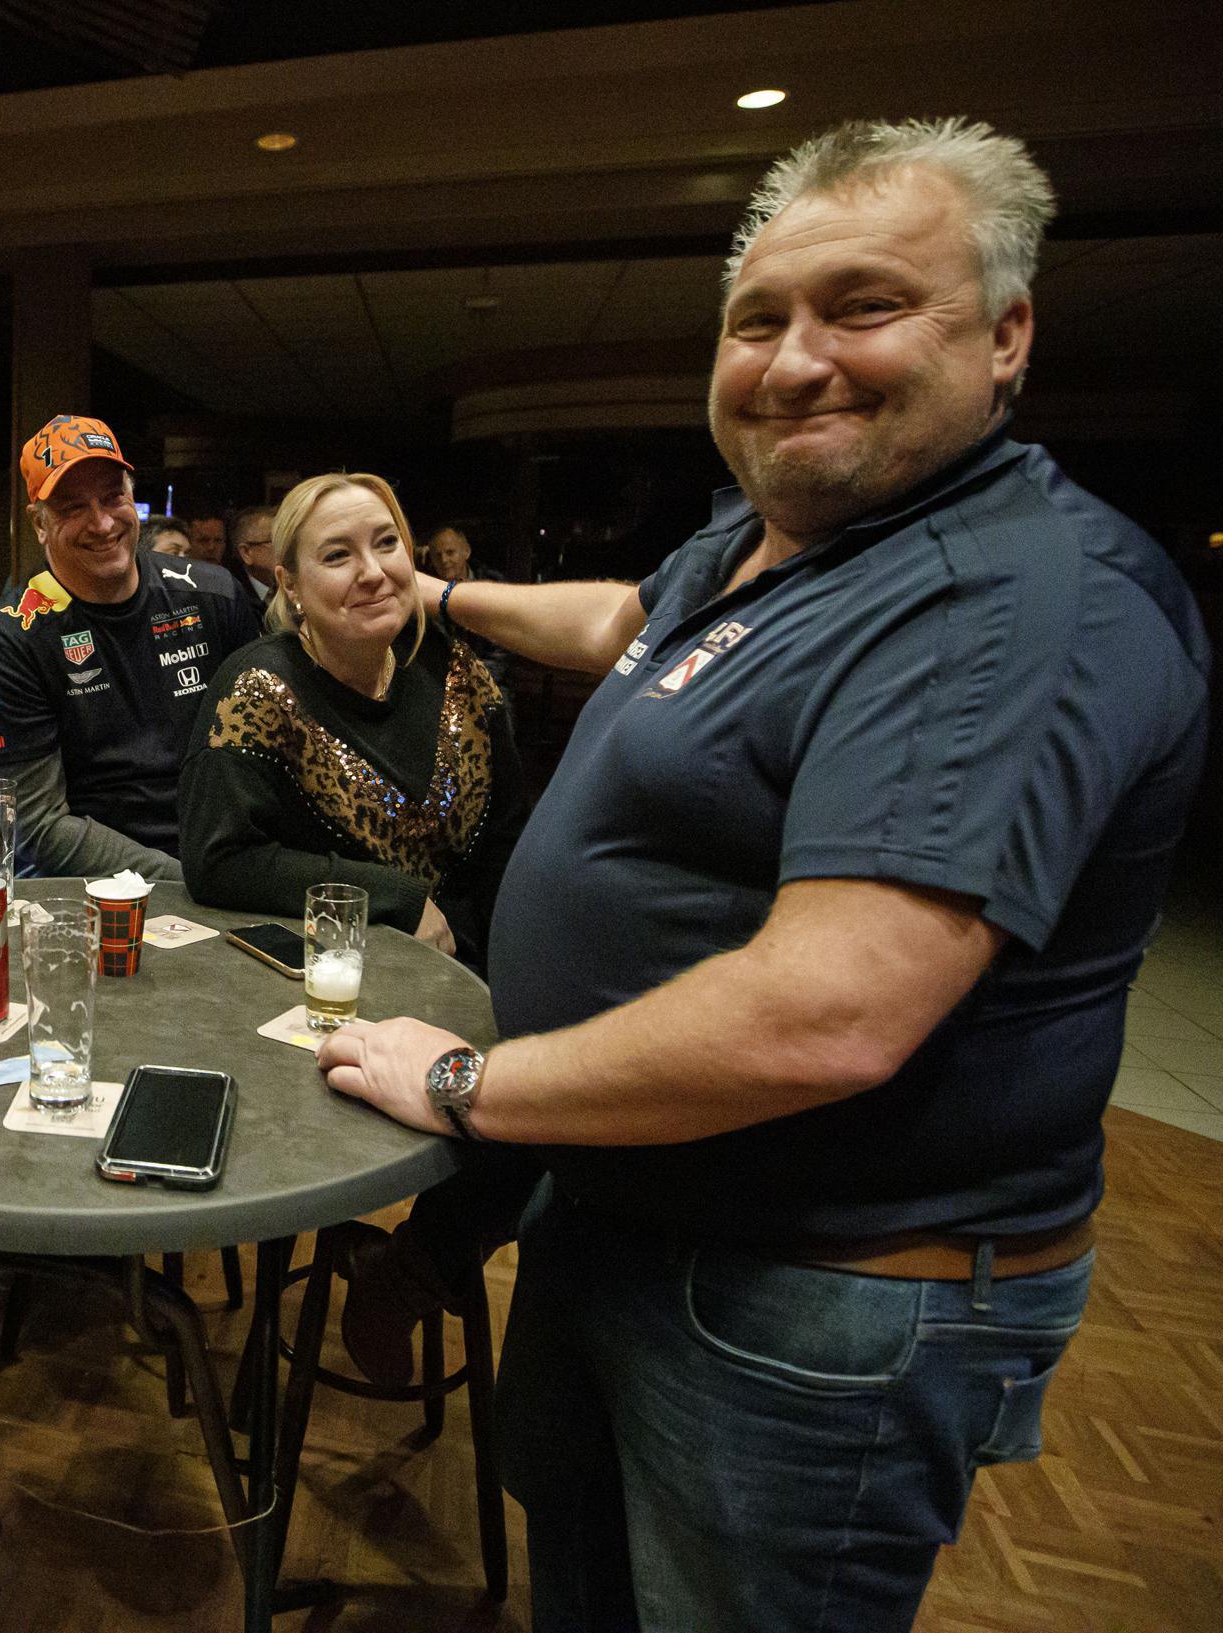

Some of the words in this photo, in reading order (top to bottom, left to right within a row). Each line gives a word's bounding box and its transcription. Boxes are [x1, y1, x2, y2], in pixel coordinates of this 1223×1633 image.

[61, 633, 89, 647] TAG
[159, 645, 196, 667] Mobil
[84, 682, 111, 694] MARTIN
[173, 683, 208, 697] HONDA
